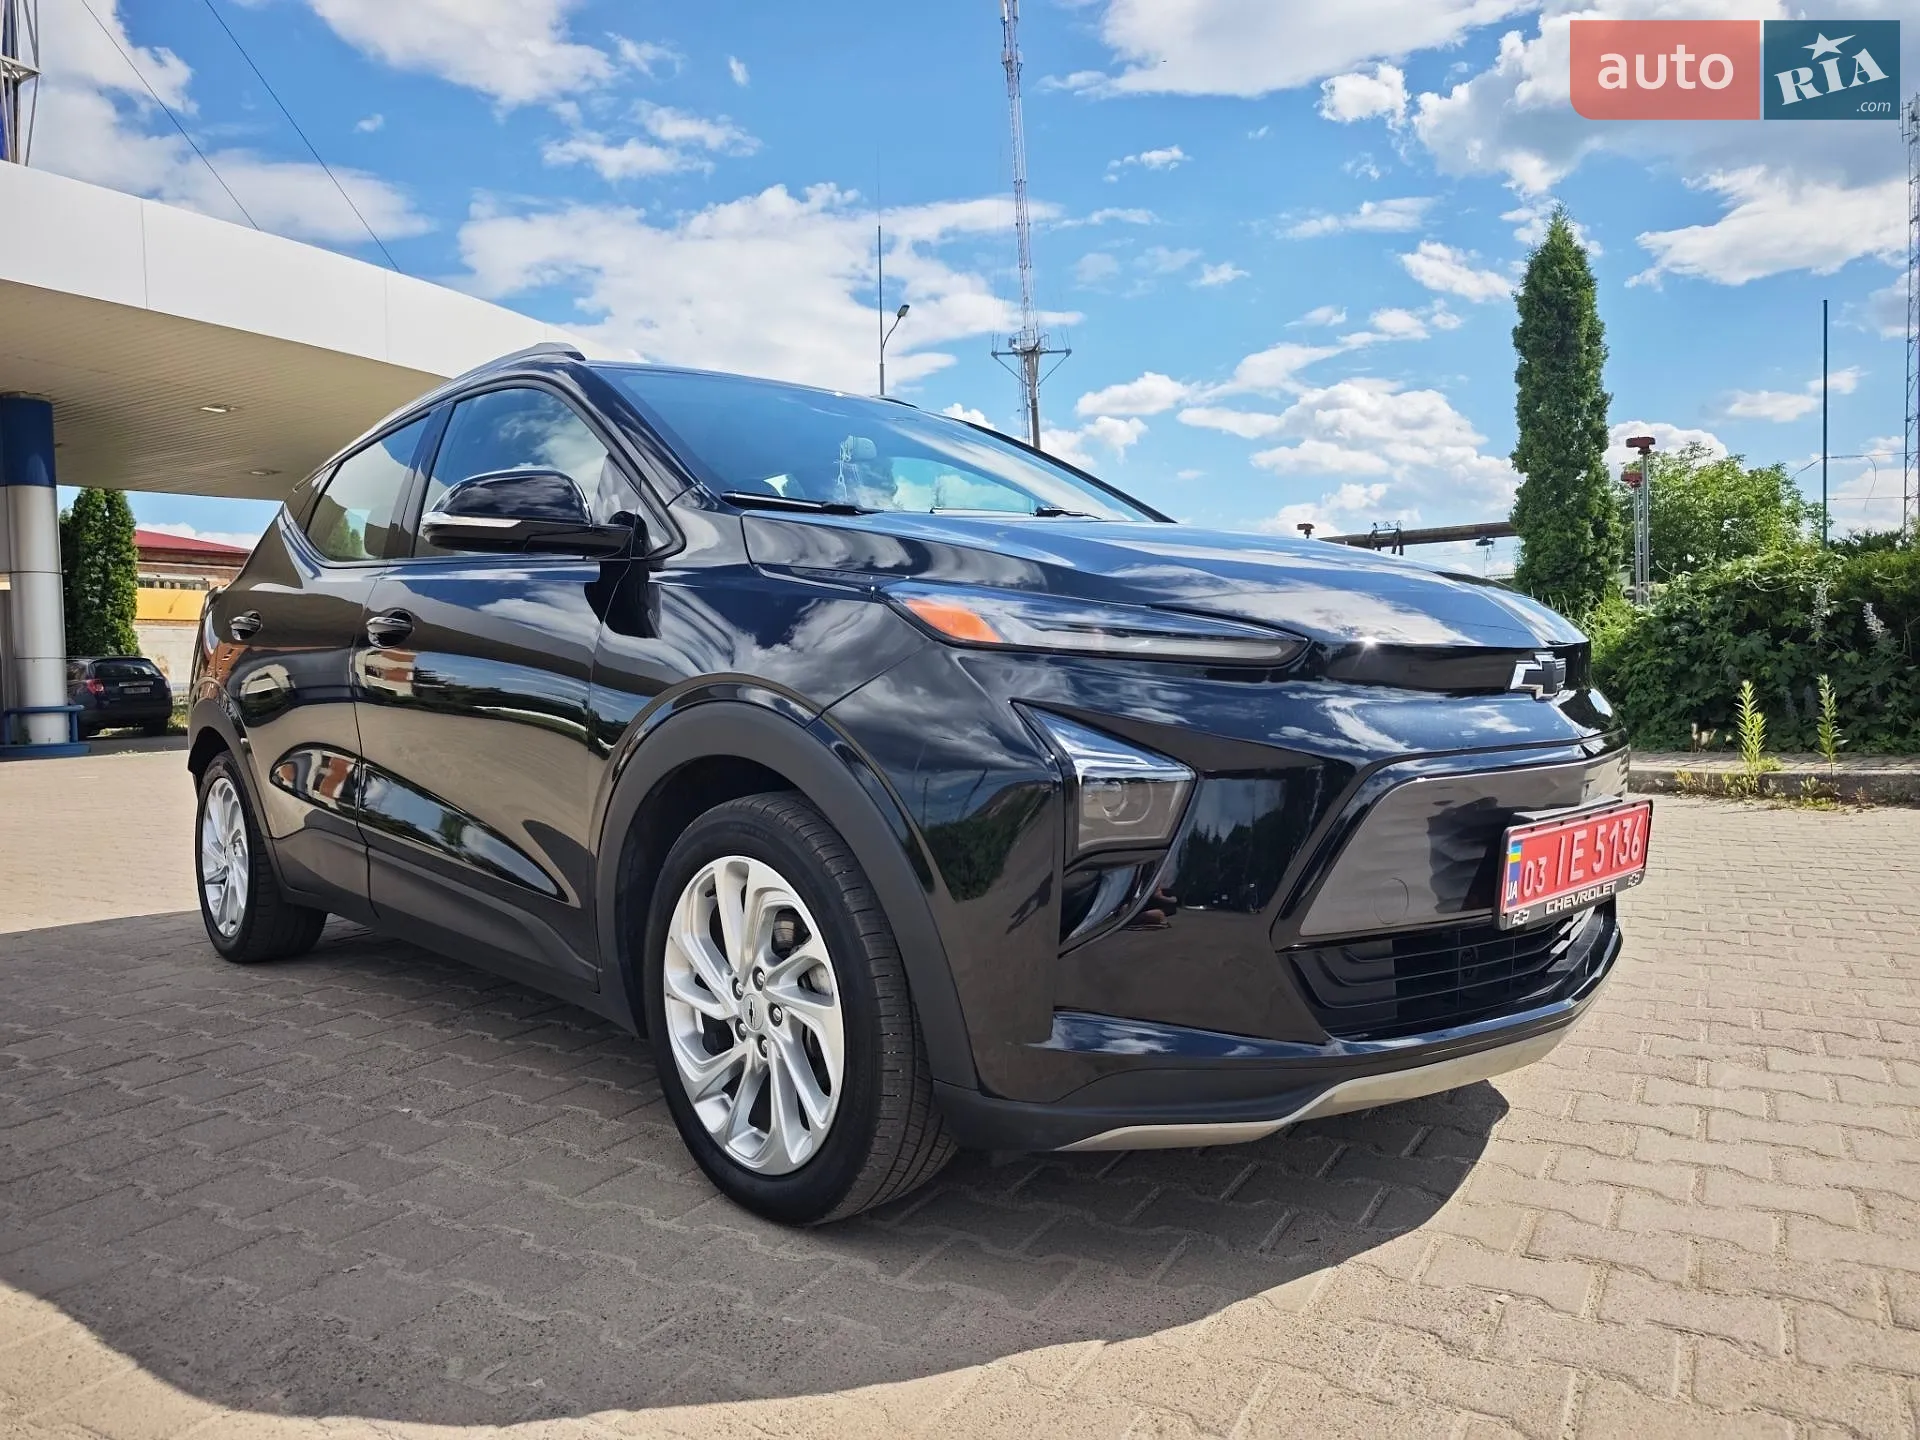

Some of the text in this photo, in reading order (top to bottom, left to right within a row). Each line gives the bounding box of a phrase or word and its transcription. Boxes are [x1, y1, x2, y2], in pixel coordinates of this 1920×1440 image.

[1523, 815, 1643, 897] 03 IE 5136
[1545, 881, 1616, 914] CHEVROLET
